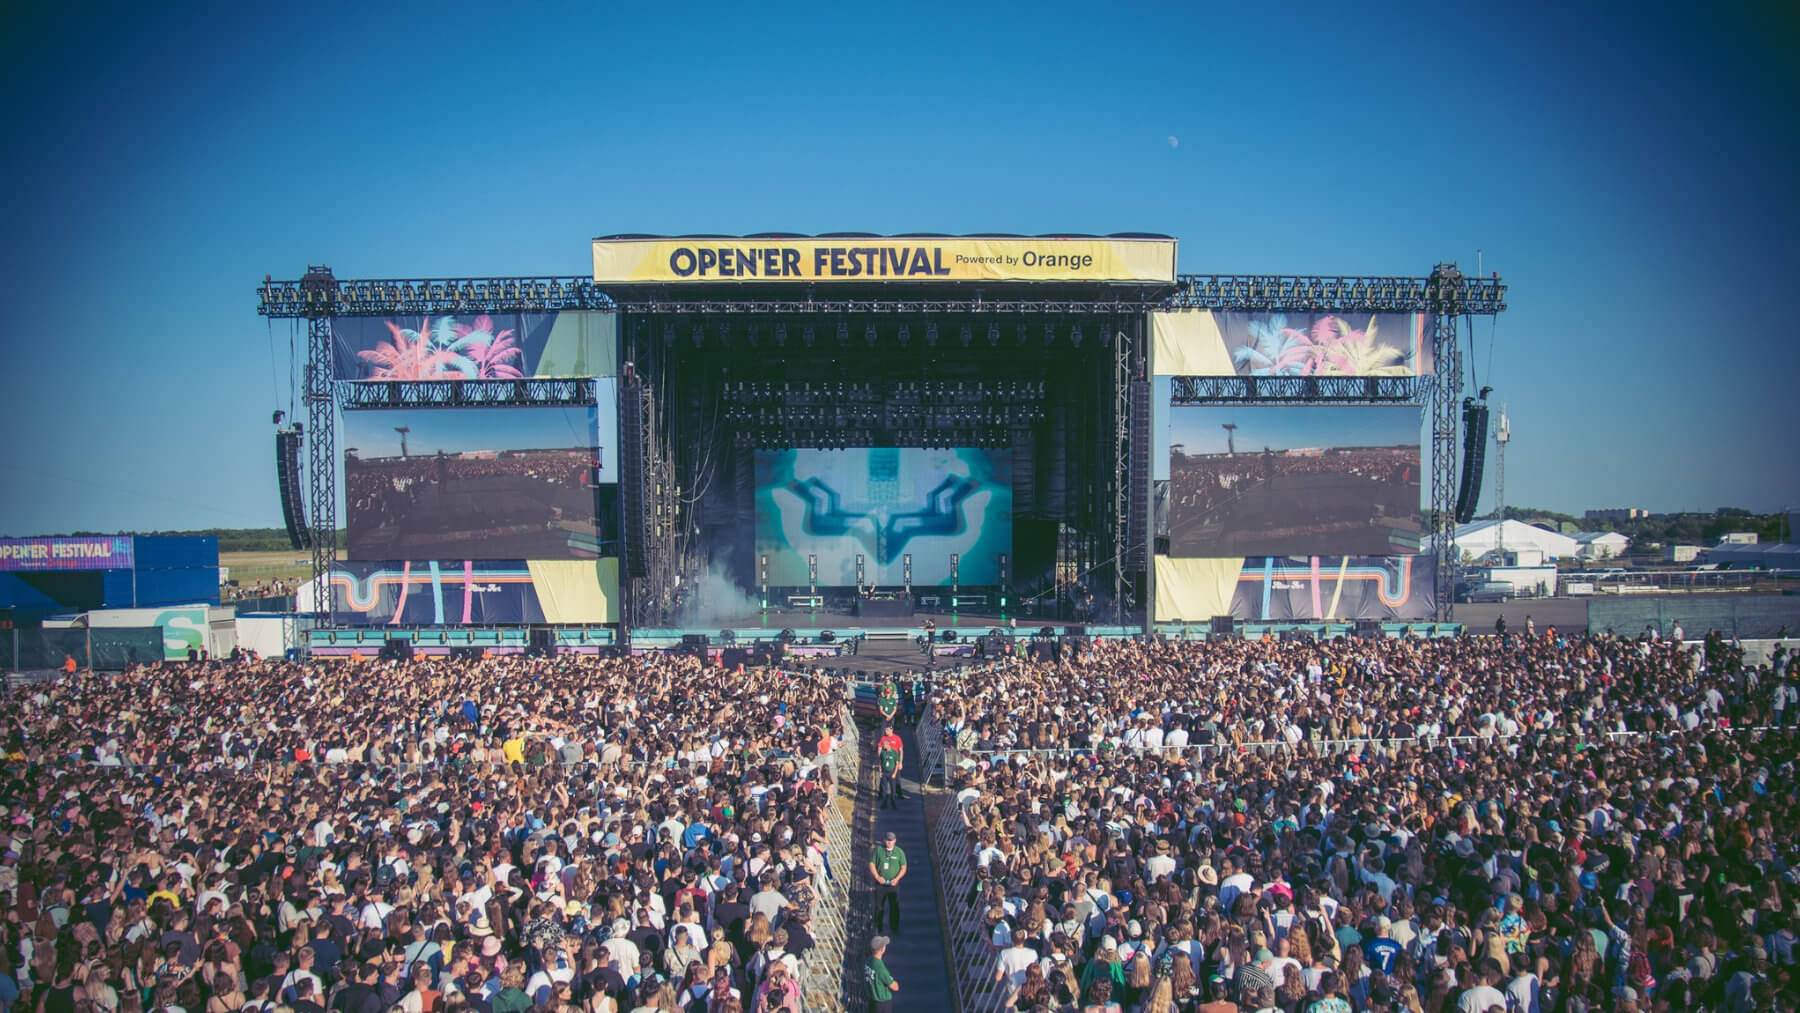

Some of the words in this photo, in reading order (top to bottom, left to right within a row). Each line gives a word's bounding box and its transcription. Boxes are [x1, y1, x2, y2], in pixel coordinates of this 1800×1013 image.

[669, 247, 802, 277] OPEN'ER
[814, 247, 951, 276] FESTIVAL
[955, 254, 1003, 264] Powered
[1006, 254, 1019, 266] by
[1022, 250, 1093, 270] Orange
[0, 543, 49, 560] PEN'ER
[52, 542, 112, 559] FESTIVAL
[1380, 951, 1391, 970] 7
